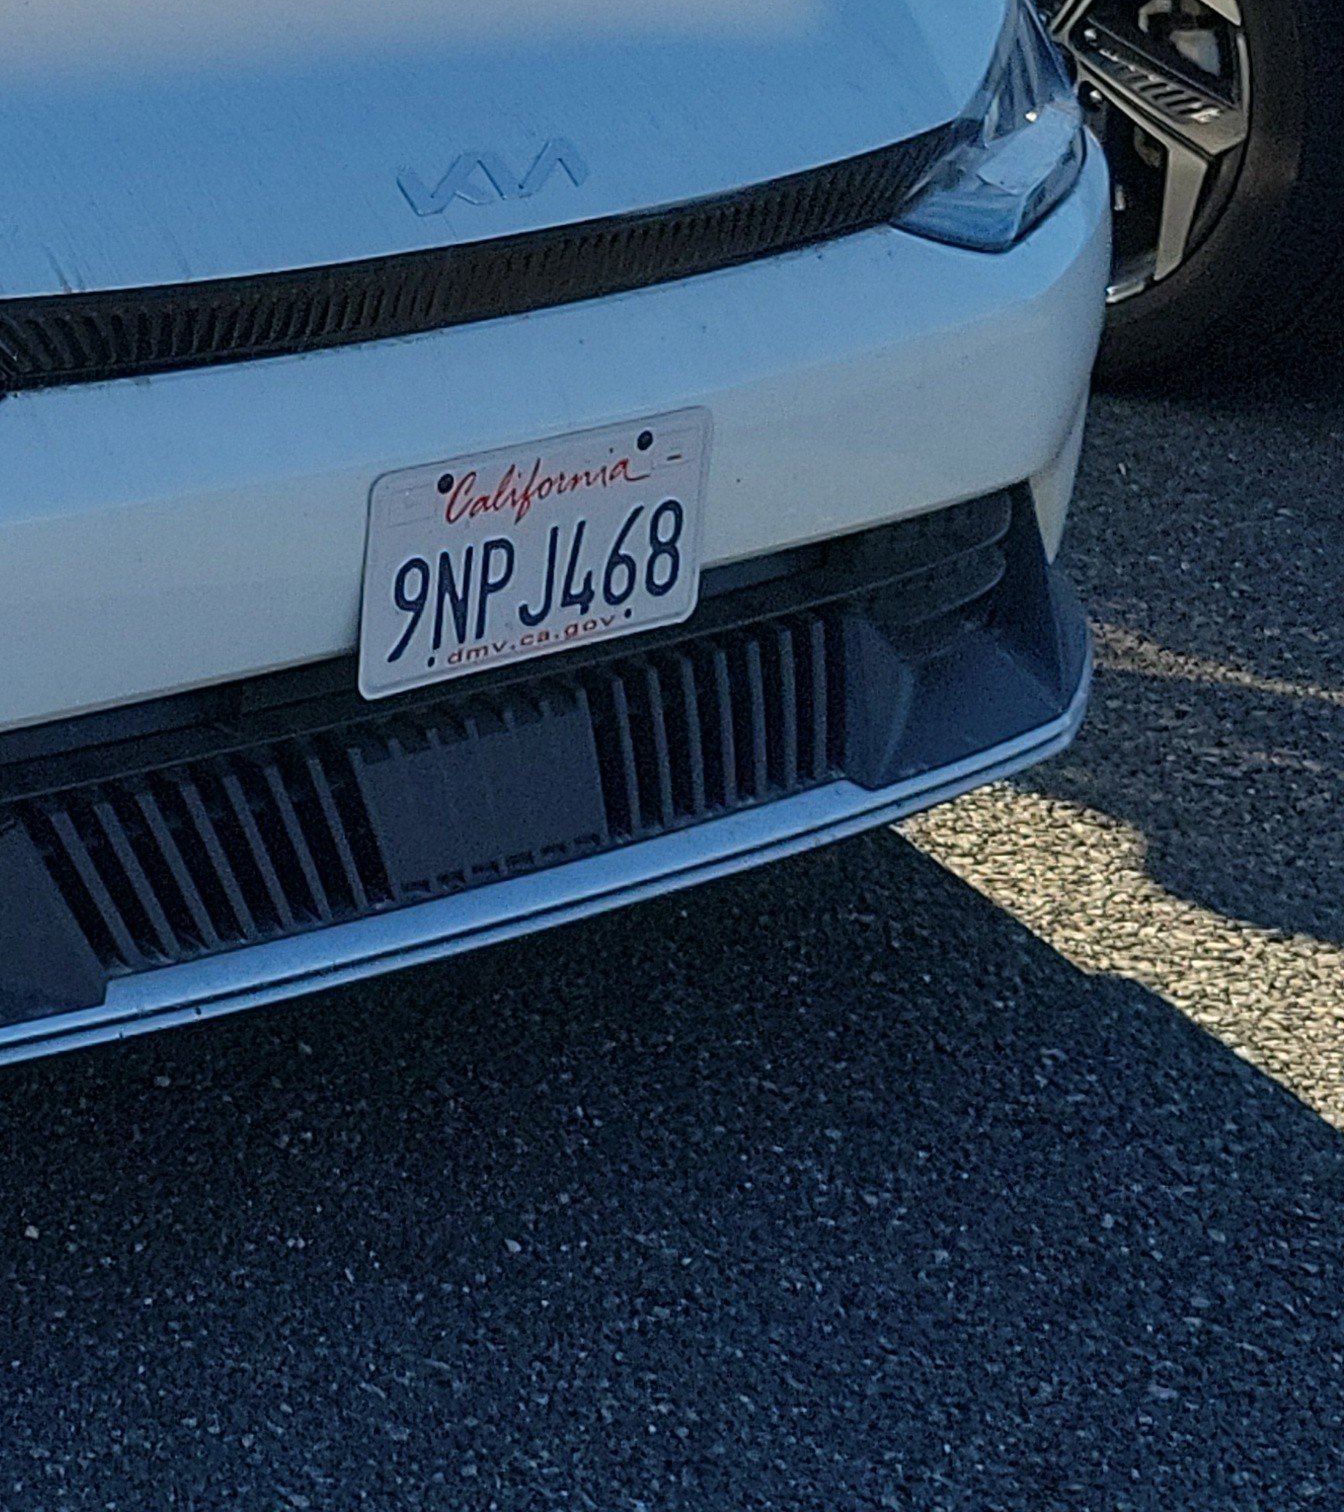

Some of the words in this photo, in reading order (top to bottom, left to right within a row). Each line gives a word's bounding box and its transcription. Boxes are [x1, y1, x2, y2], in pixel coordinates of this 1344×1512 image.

[395, 138, 589, 217] KIA
[444, 447, 650, 525] California
[385, 498, 684, 664] 9NPJ468
[446, 614, 615, 667] dmv.ca.gov
